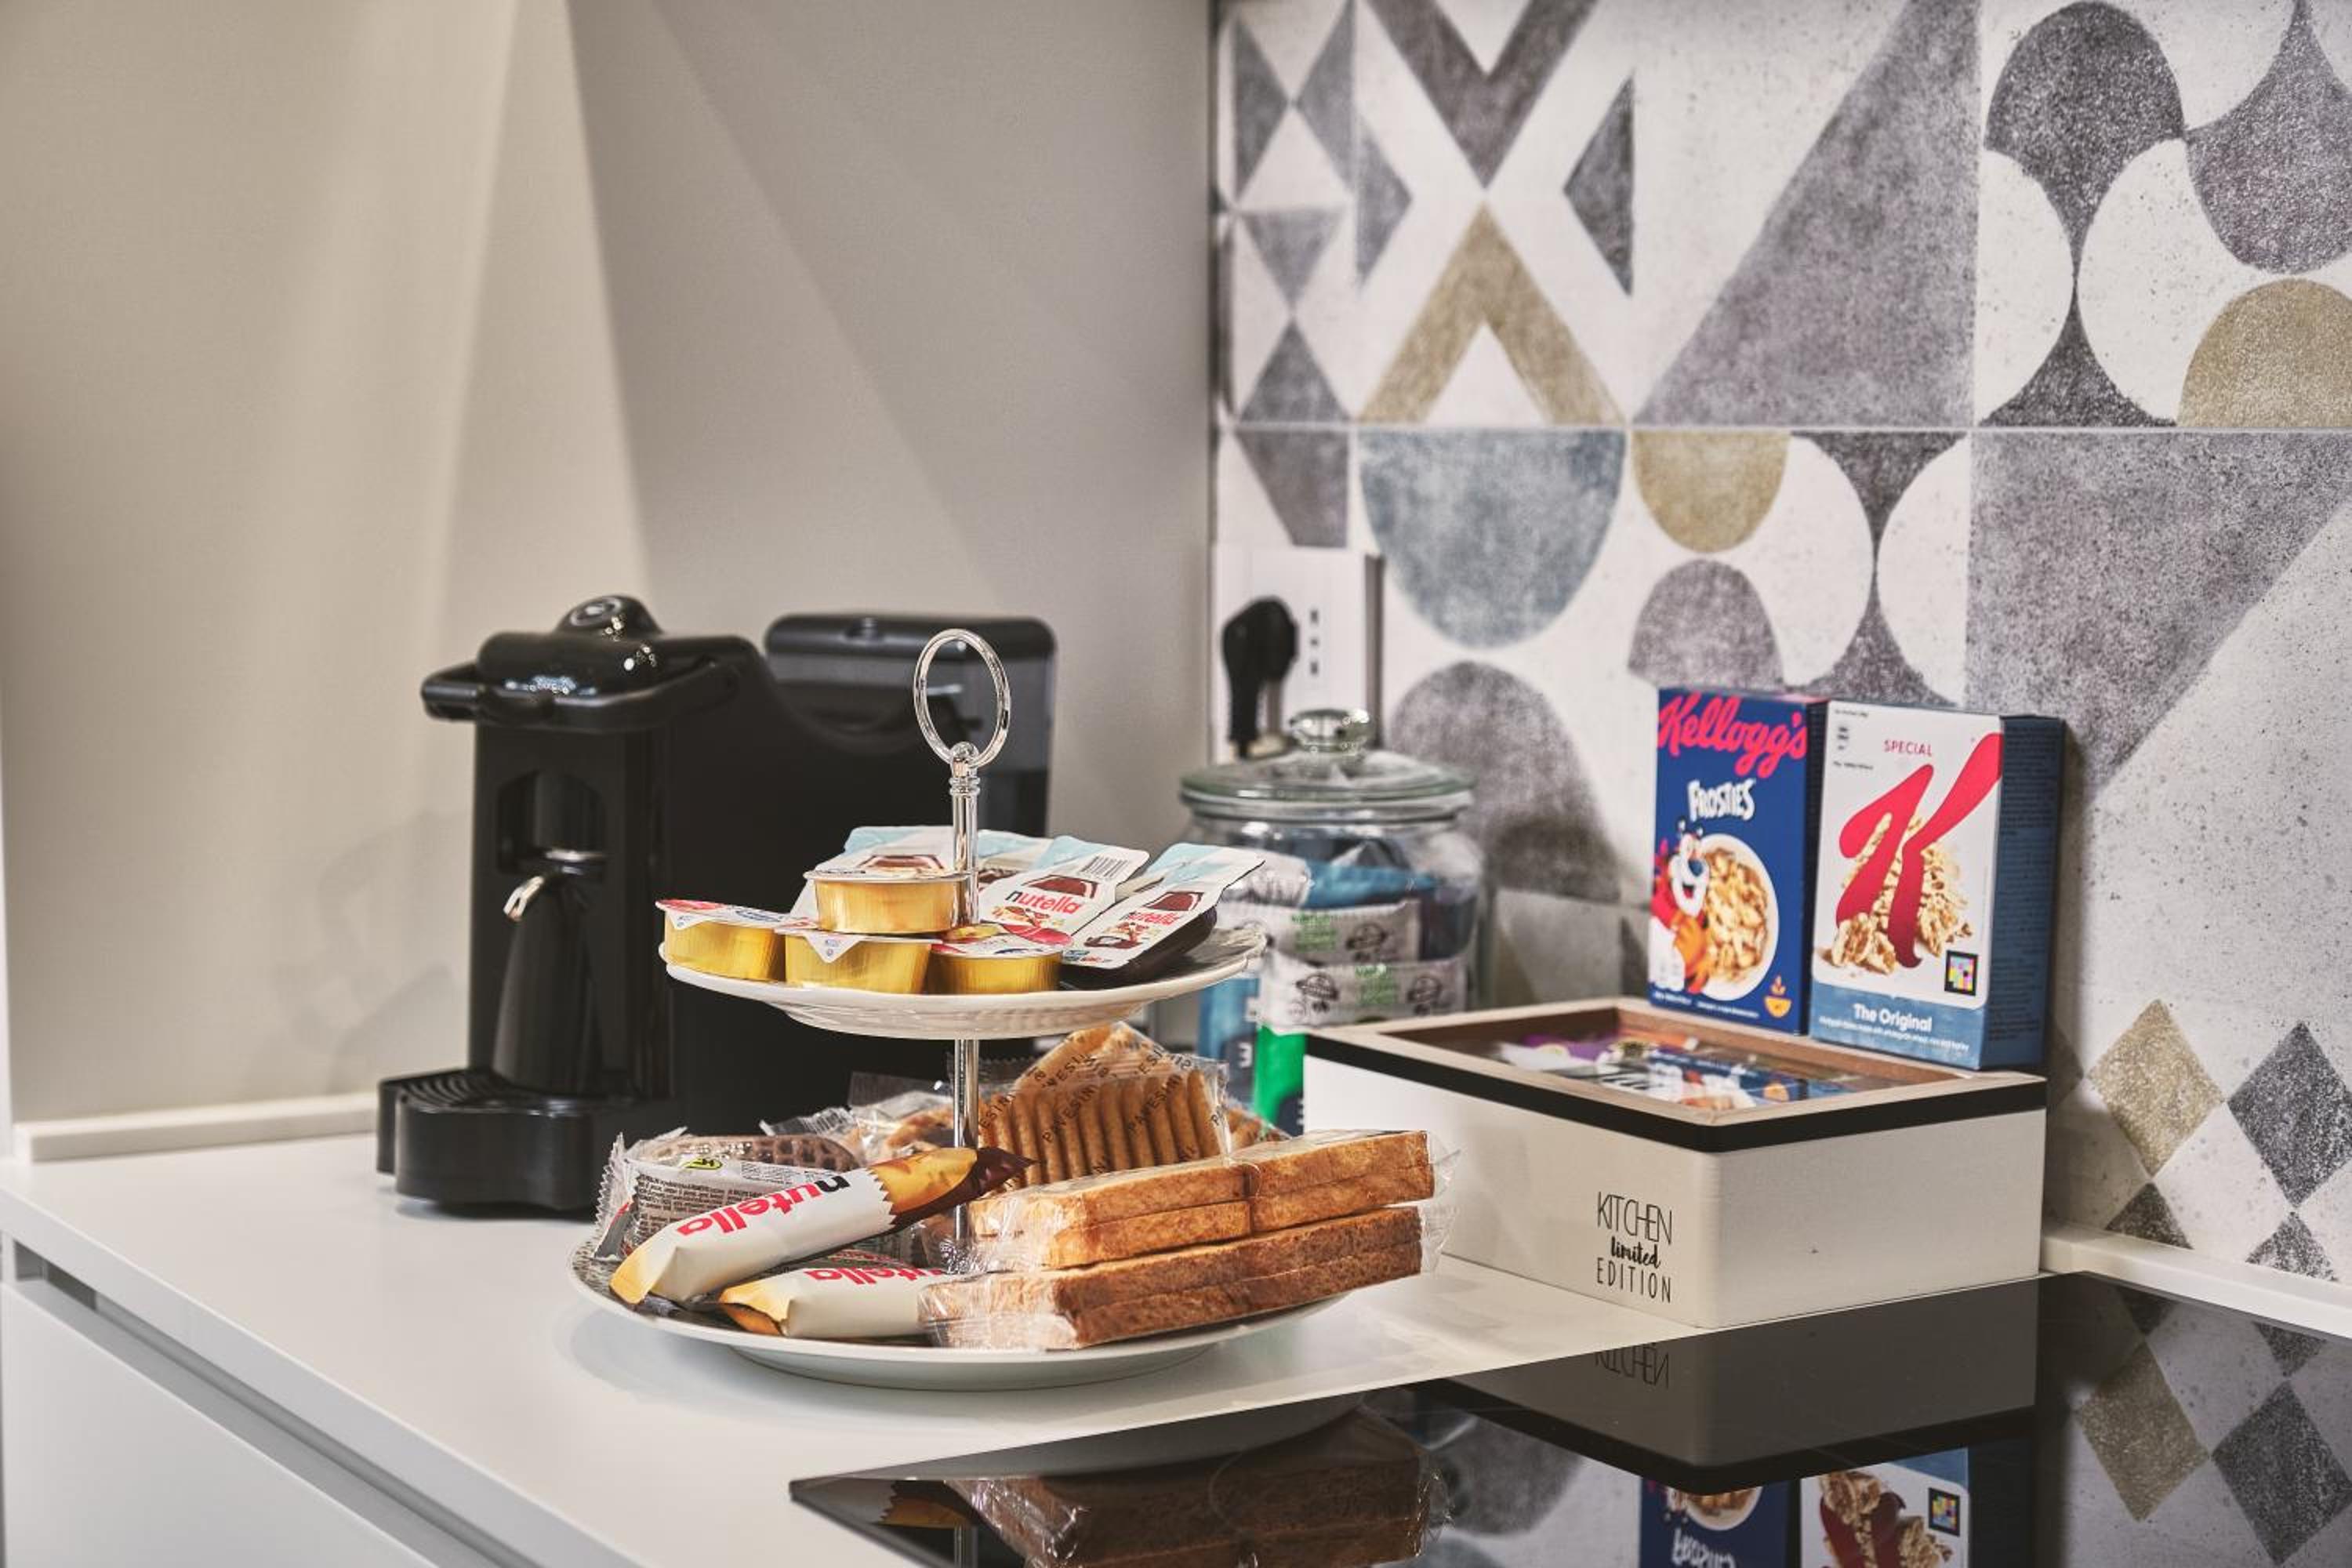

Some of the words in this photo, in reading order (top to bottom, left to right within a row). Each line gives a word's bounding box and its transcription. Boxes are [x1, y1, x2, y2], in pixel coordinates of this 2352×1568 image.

[1657, 691, 1807, 778] Kellogg's
[1884, 739, 1933, 757] SPECIAL
[1688, 779, 1756, 822] FROSTIES
[1005, 890, 1083, 915] nutella
[1853, 1003, 1877, 1022] The
[1878, 1008, 1933, 1033] Original
[677, 1174, 851, 1237] nutella
[1597, 1191, 1672, 1246] KITCHEN
[1610, 1236, 1661, 1269] limited
[1597, 1257, 1671, 1303] EDITION
